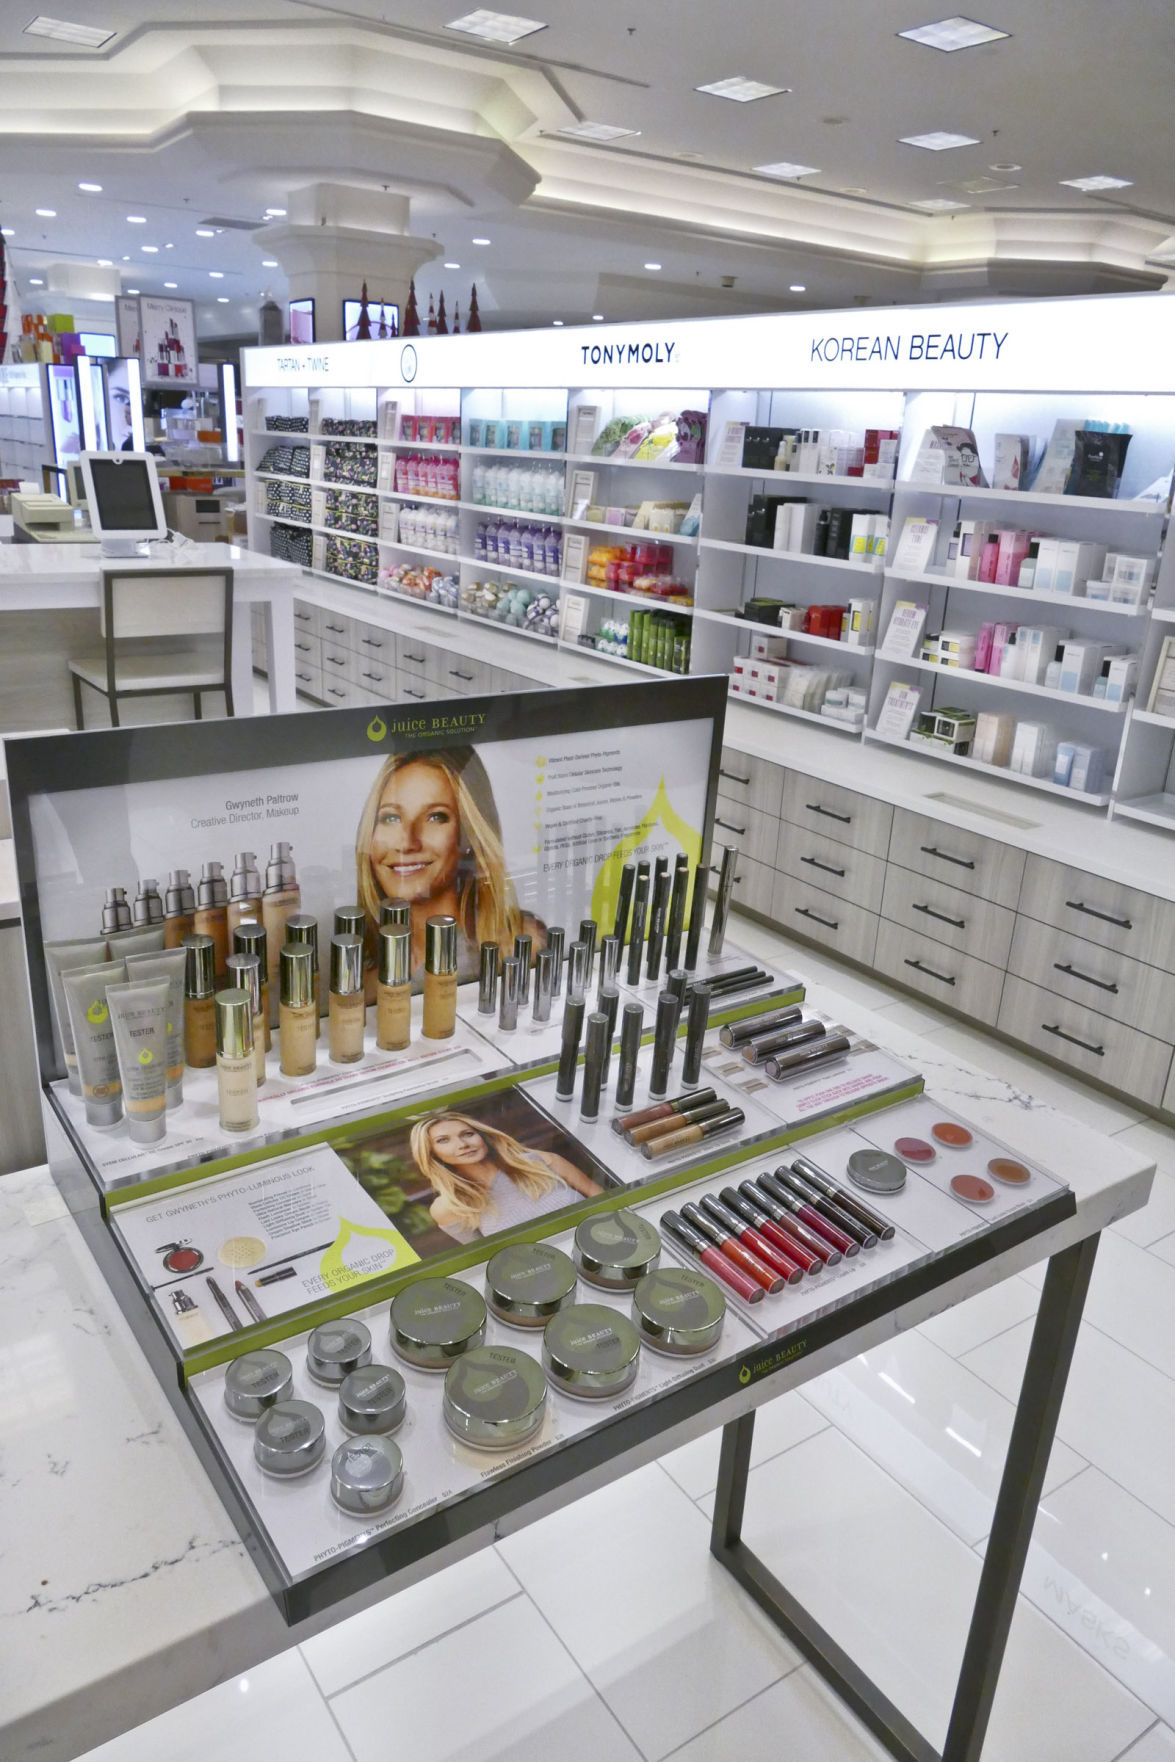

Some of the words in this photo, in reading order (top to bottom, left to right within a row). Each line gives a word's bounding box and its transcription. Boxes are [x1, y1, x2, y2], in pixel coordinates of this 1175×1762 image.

[581, 342, 675, 365] TONYMOLY
[810, 335, 901, 362] KOREAN
[908, 332, 1009, 361] BEAUTY
[307, 356, 329, 372] TWINE
[391, 718, 426, 734] juice
[431, 714, 486, 729] BEAUTY
[225, 796, 264, 811] Gwyneth
[266, 793, 299, 806] Paltrow
[190, 815, 227, 829] Creative
[266, 806, 300, 818] Makeup
[129, 1027, 155, 1038] TESTER
[146, 1213, 163, 1223] GET
[166, 1197, 217, 1217] GWYNETH'S
[217, 1173, 292, 1201] PHYTO-LUMINOUS
[293, 1166, 315, 1178] LOOK
[302, 1272, 329, 1288] EVERY
[331, 1257, 371, 1276] ORGANIC
[371, 1248, 395, 1260] DROP
[306, 1280, 336, 1295] FEEDS
[337, 1270, 361, 1284] YOUR
[489, 1352, 516, 1363] TESTER
[752, 1356, 774, 1374] juice
[775, 1339, 808, 1362] BEAUTY
[480, 1462, 506, 1478] Flawless
[505, 1449, 532, 1466] Finishing
[375, 1511, 408, 1531] Perfecting
[407, 1496, 438, 1515] Concealer
